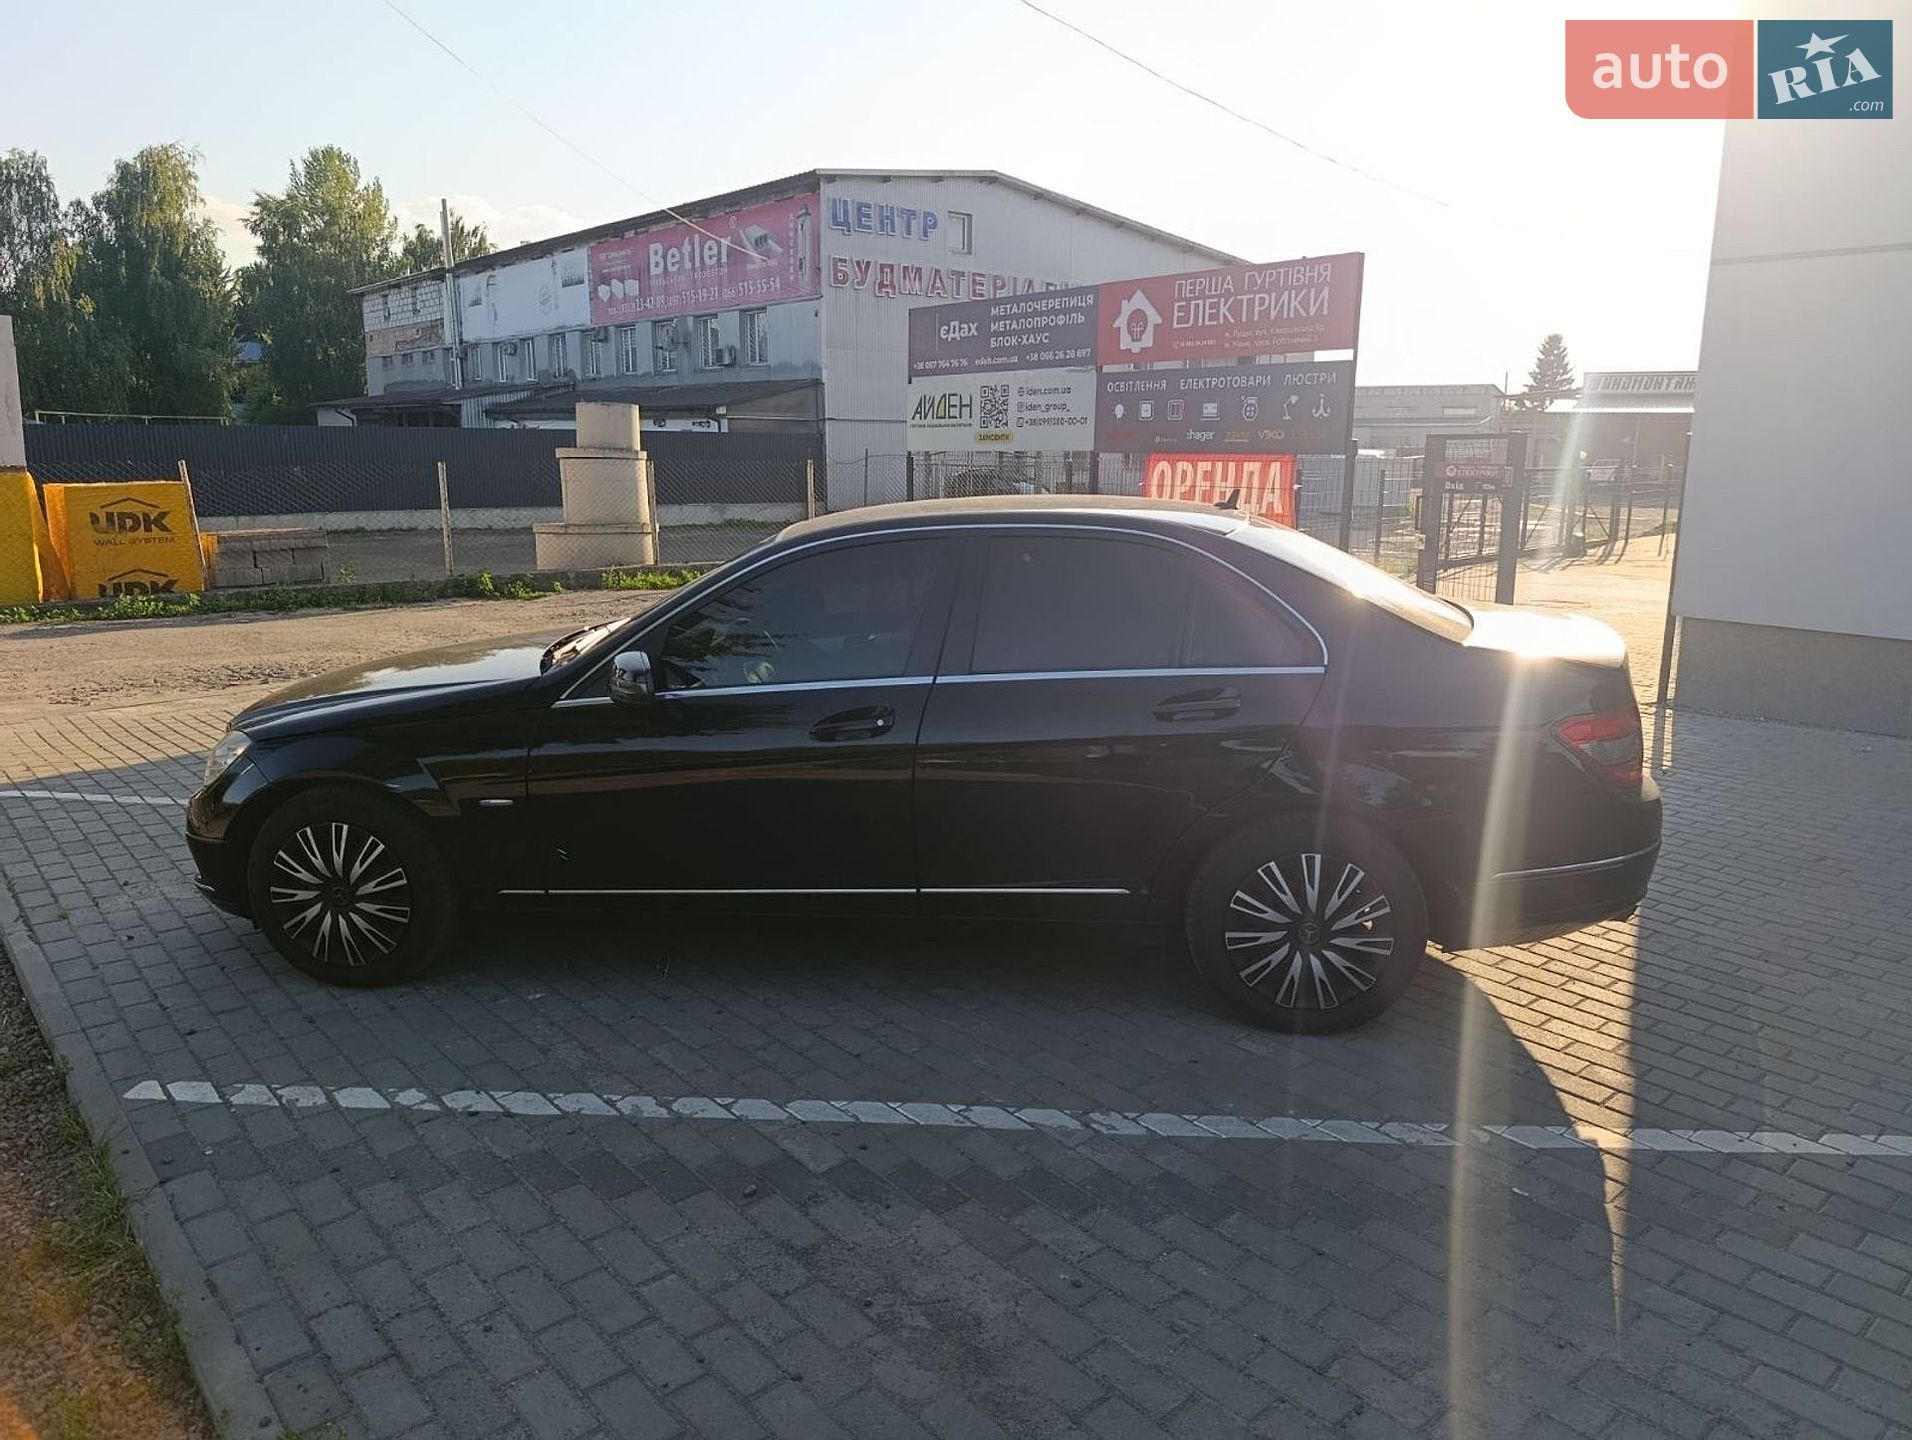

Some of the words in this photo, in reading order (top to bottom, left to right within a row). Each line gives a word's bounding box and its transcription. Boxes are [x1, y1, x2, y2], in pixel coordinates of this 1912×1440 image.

[829, 197, 938, 241] ЦЕНТР
[649, 235, 731, 277] Betler
[830, 255, 1078, 301] БУДМАТЕРІА
[1174, 275, 1234, 299] ПЕРША
[1244, 263, 1331, 290] ГУРТІВНЯ
[990, 294, 1094, 317] МЕТАЛОЧЕРЕПИЦЯ
[1173, 287, 1329, 329] ЕЛЕКТРИКИ
[940, 320, 978, 342] єДах
[990, 312, 1085, 333] МЕТАЛОПРОФІЛЬ
[1107, 379, 1167, 393] ОСВІТЛЕННЯ
[1180, 375, 1271, 391] ЕЛЕКТРОТОВАРИ
[1283, 372, 1337, 386] ЛЮСТРИ
[912, 392, 973, 420] АЙДЕН
[1151, 461, 1284, 514] ОРЕНДА
[88, 510, 173, 535] UDK
